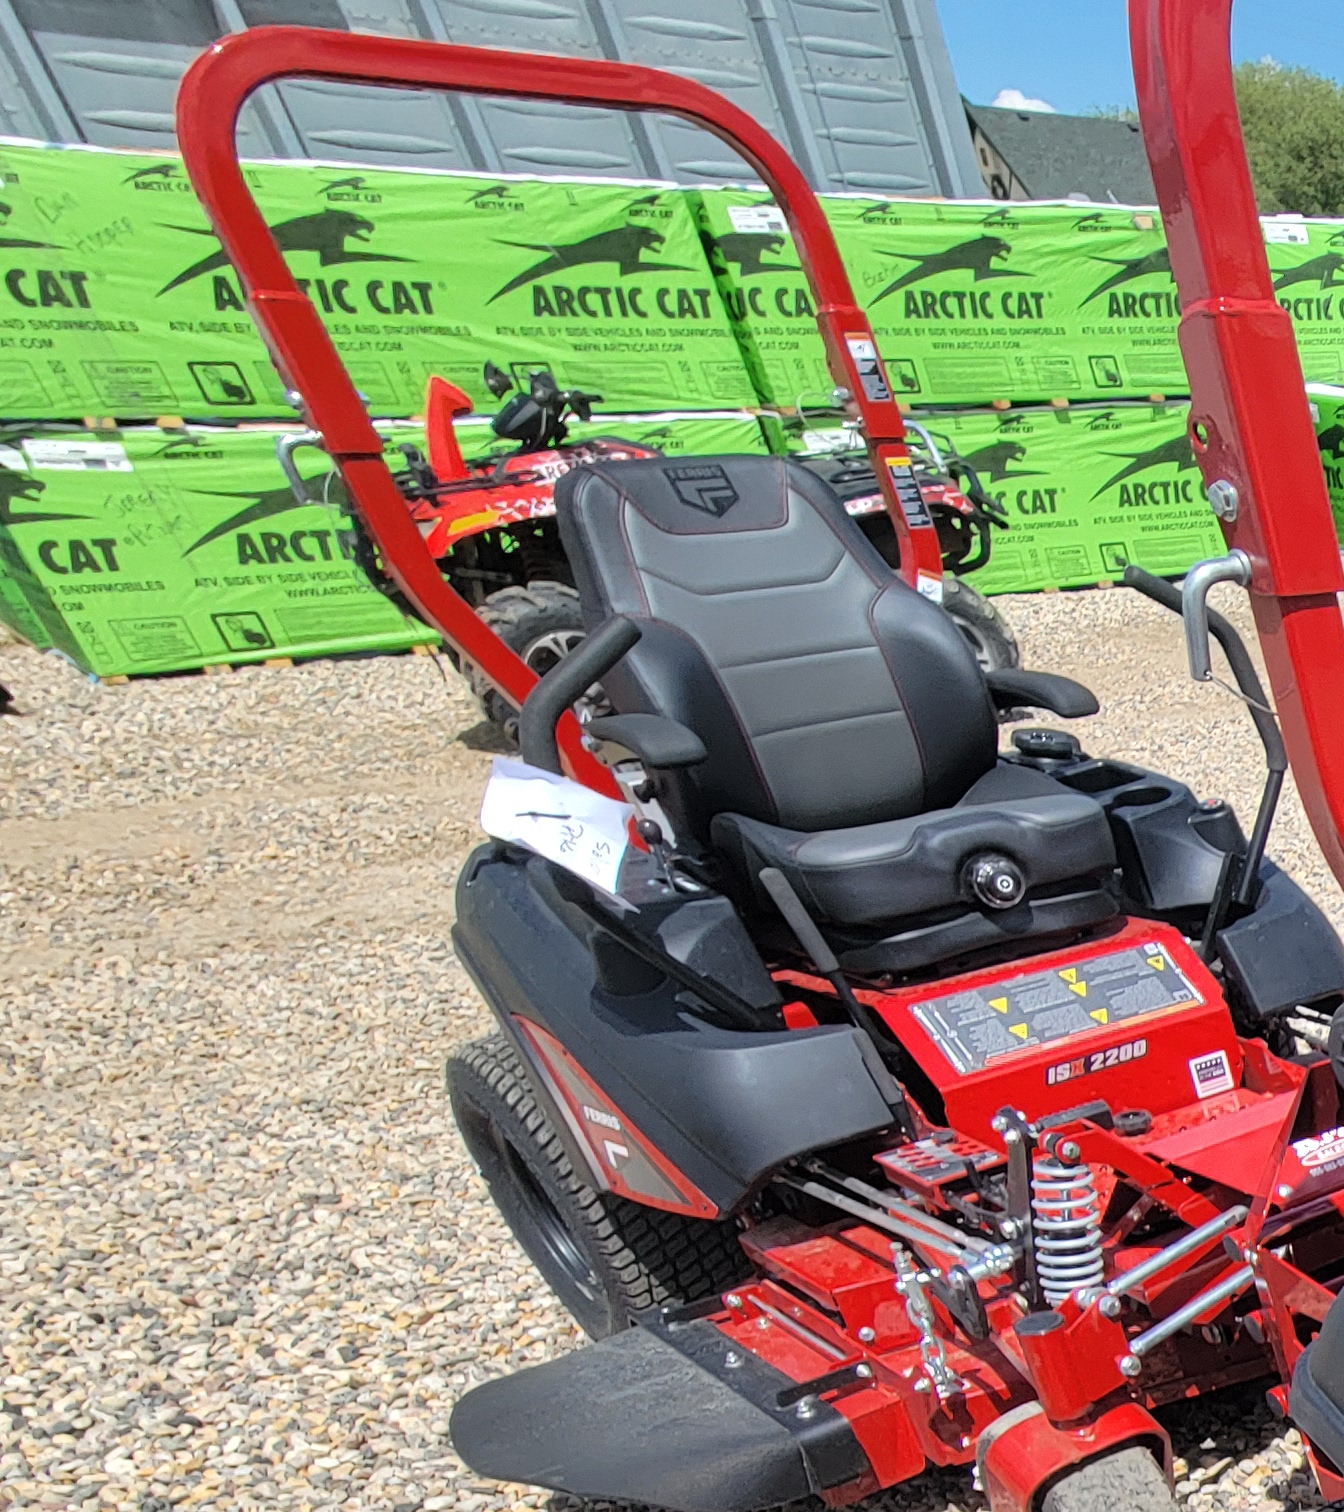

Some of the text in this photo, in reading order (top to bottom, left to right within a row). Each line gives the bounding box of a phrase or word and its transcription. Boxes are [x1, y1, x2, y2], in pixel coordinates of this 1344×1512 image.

[5, 268, 92, 308] CAT
[366, 279, 434, 315] CAT
[533, 284, 648, 318] ARCTIC
[656, 288, 711, 319] CAT
[775, 287, 817, 318] CA
[904, 290, 1043, 319] ARCTIC CAT
[1017, 489, 1057, 515] CAT
[1119, 480, 1193, 508] ARCTIC
[38, 538, 120, 574] CAT
[60, 580, 165, 595] SNOWMOBILES
[1047, 1039, 1147, 1085] ISX 2200
[583, 1106, 621, 1131] FERRIS
